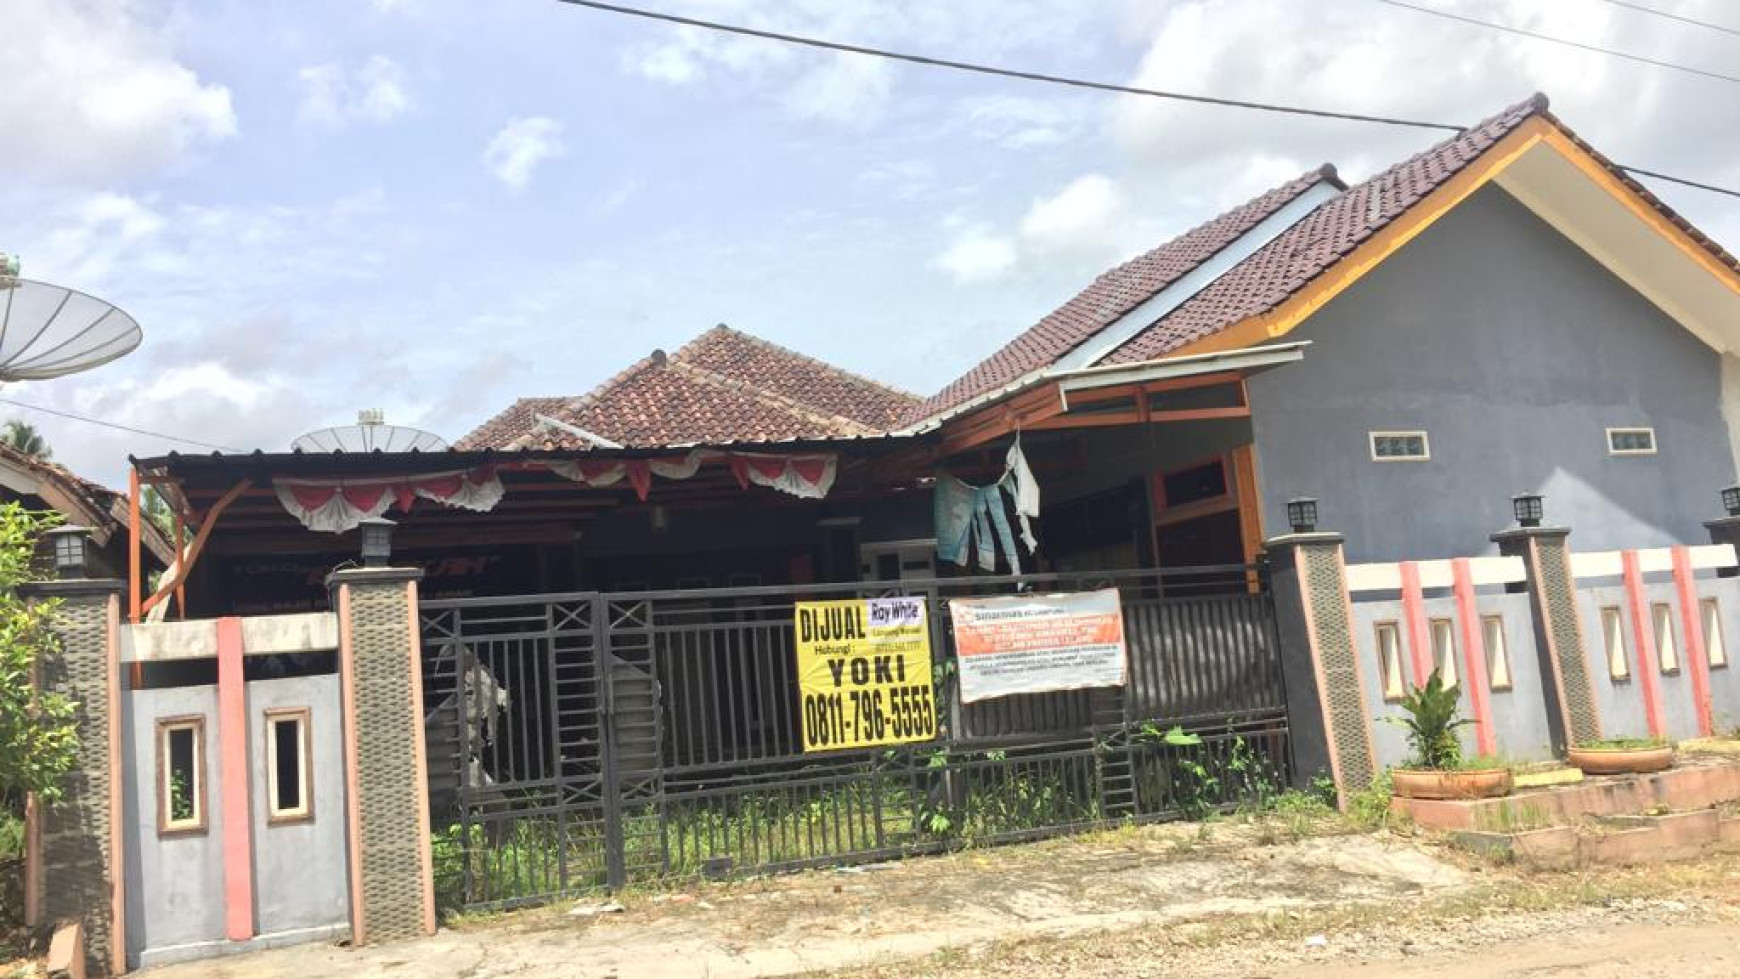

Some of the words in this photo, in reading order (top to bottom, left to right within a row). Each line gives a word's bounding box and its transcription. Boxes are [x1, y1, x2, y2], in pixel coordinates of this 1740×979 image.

[800, 606, 866, 643] DIJUAL
[871, 602, 891, 623] Ray
[891, 601, 919, 619] White
[827, 654, 906, 687] YOKI
[804, 684, 934, 746] 0811-796-5555
